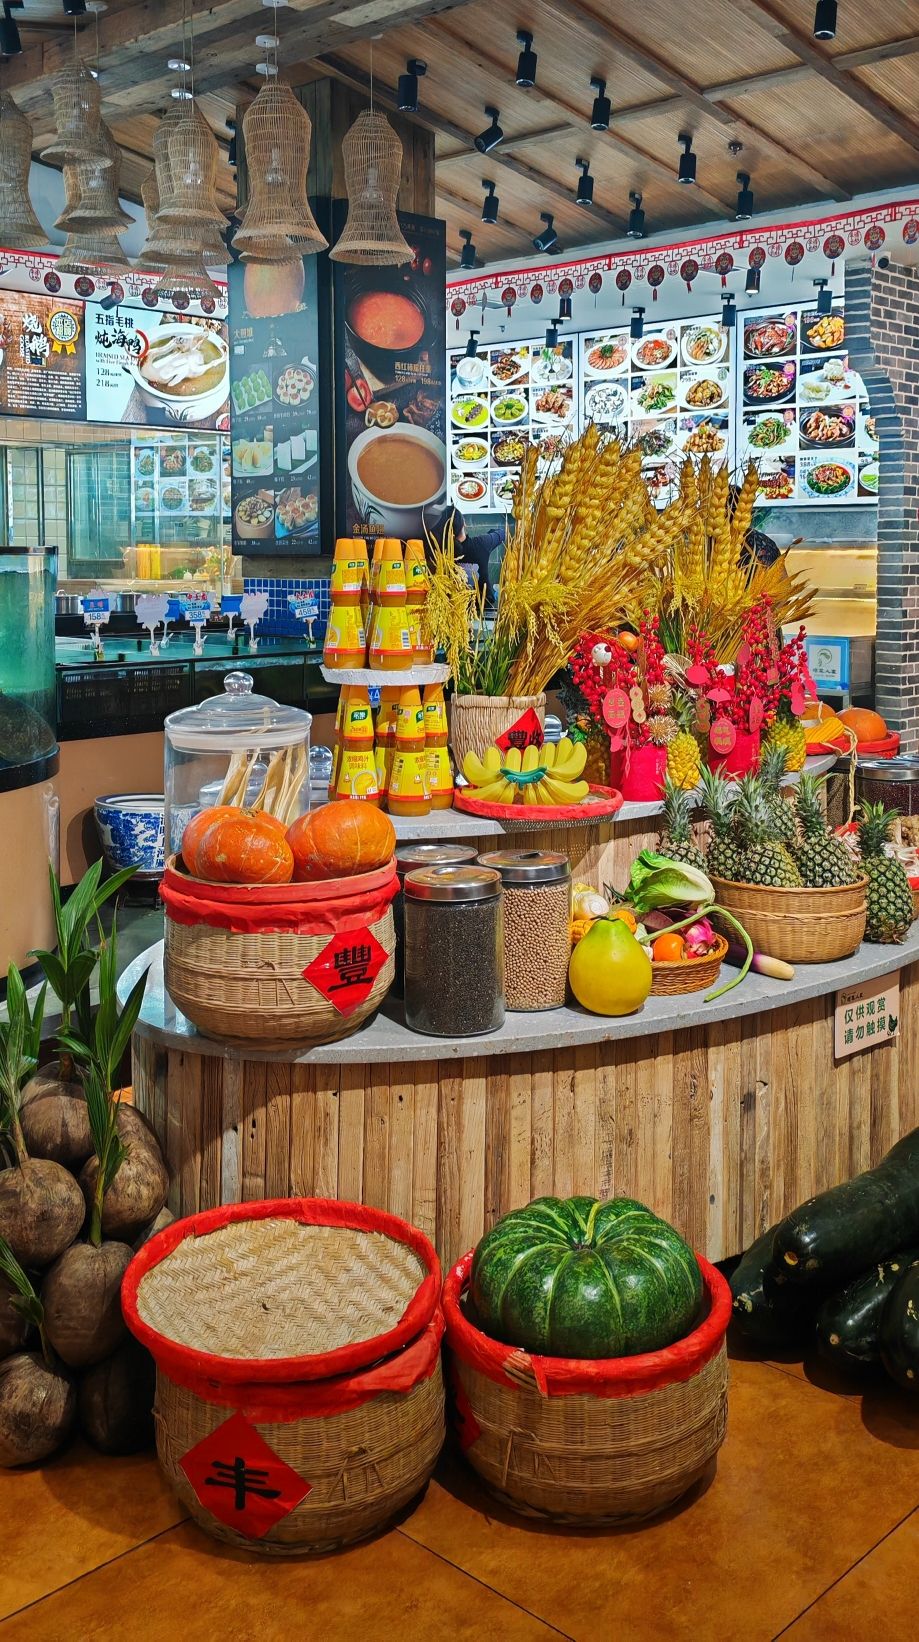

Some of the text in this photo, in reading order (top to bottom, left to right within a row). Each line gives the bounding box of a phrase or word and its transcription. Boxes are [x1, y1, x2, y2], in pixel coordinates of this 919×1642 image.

[95, 313, 134, 328] 五指毛桃
[95, 328, 141, 355] 炖海鸭
[327, 945, 375, 993] 豐
[844, 997, 886, 1025] 仅供观赏
[844, 1016, 886, 1044] 请勿触摸
[204, 1456, 281, 1511] 丰
